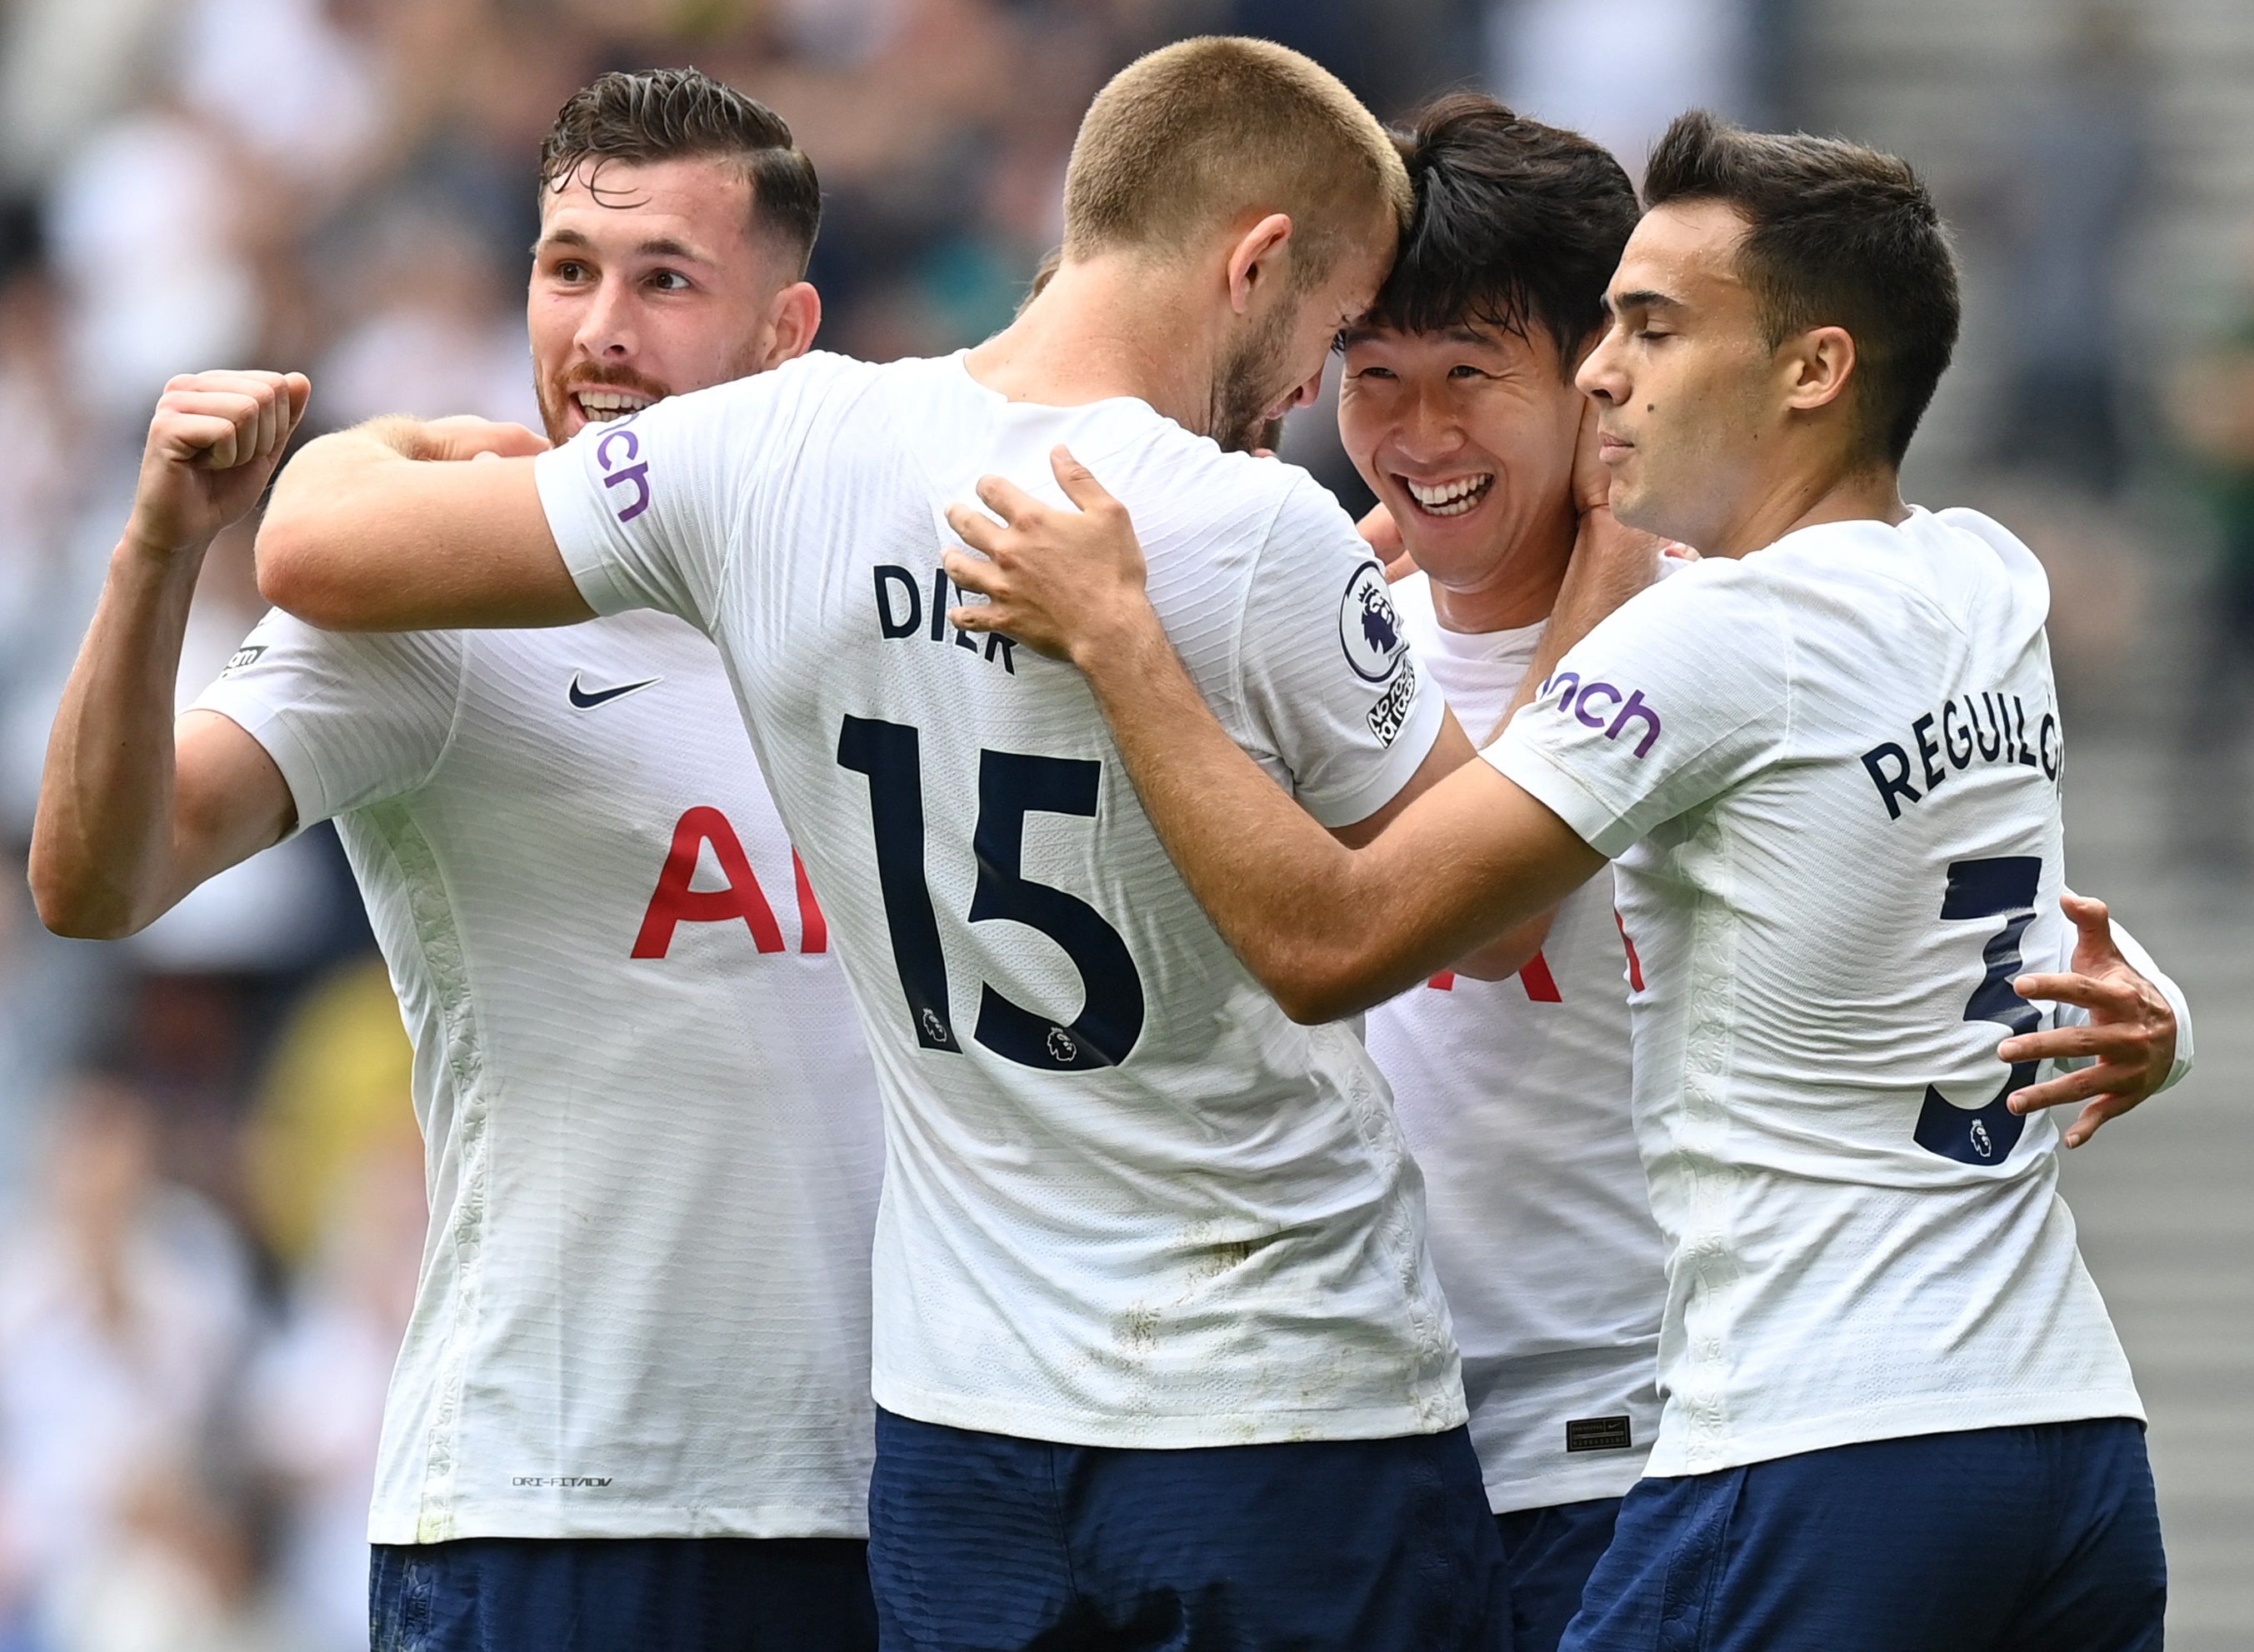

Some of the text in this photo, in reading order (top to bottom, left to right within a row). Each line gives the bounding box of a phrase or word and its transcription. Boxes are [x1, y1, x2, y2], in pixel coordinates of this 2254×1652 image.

[1367, 698, 1389, 732] No
[1376, 714, 1397, 747] for
[837, 713, 1145, 1071] 15
[1913, 856, 2042, 1166] 3
